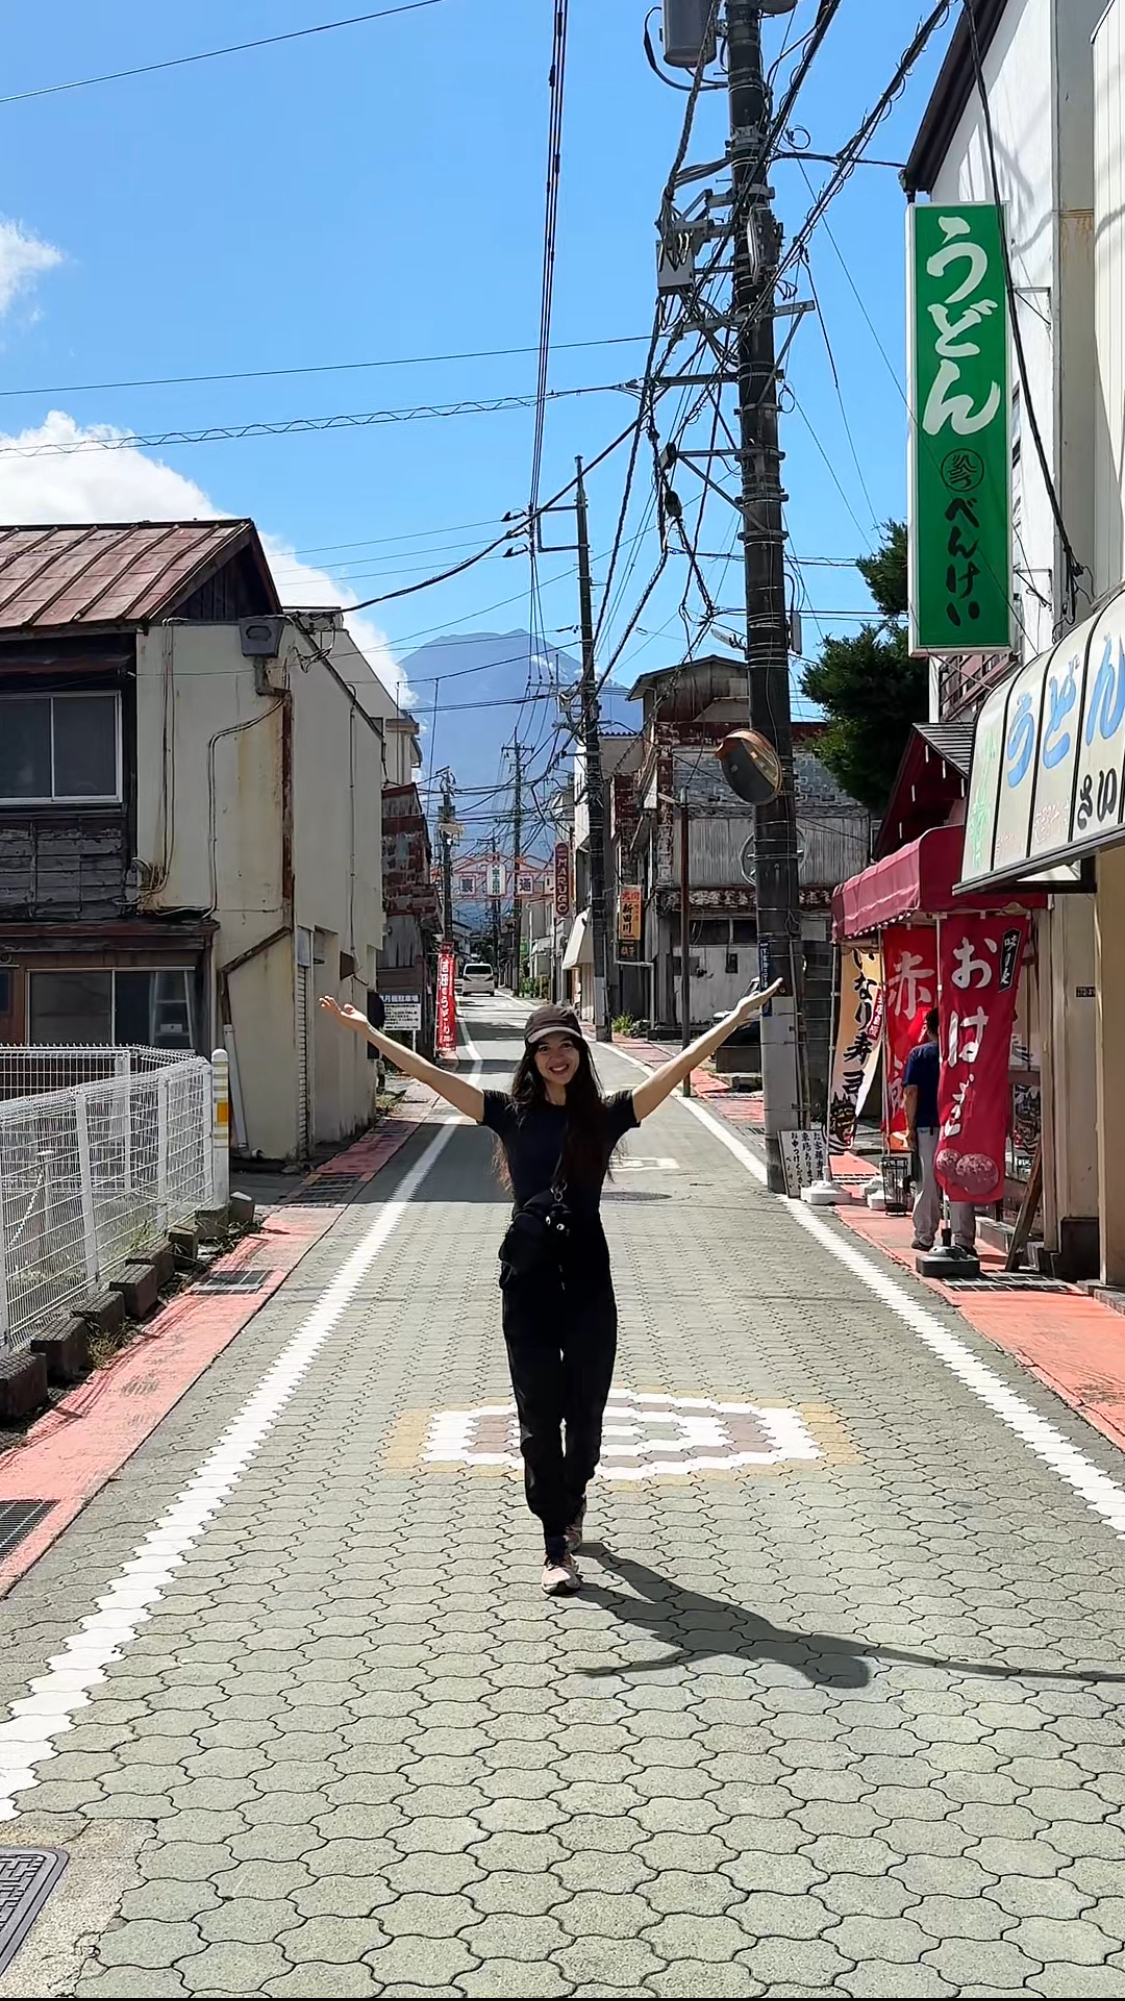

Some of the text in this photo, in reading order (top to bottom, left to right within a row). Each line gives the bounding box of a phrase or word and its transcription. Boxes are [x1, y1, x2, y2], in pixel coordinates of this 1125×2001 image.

[922, 215, 1001, 435] うどん
[944, 497, 980, 627] べんけい
[1006, 633, 1125, 789] うどん
[556, 858, 568, 913] MARUGO
[842, 948, 875, 1099] いなり寿司
[944, 936, 998, 1137] おはぎ
